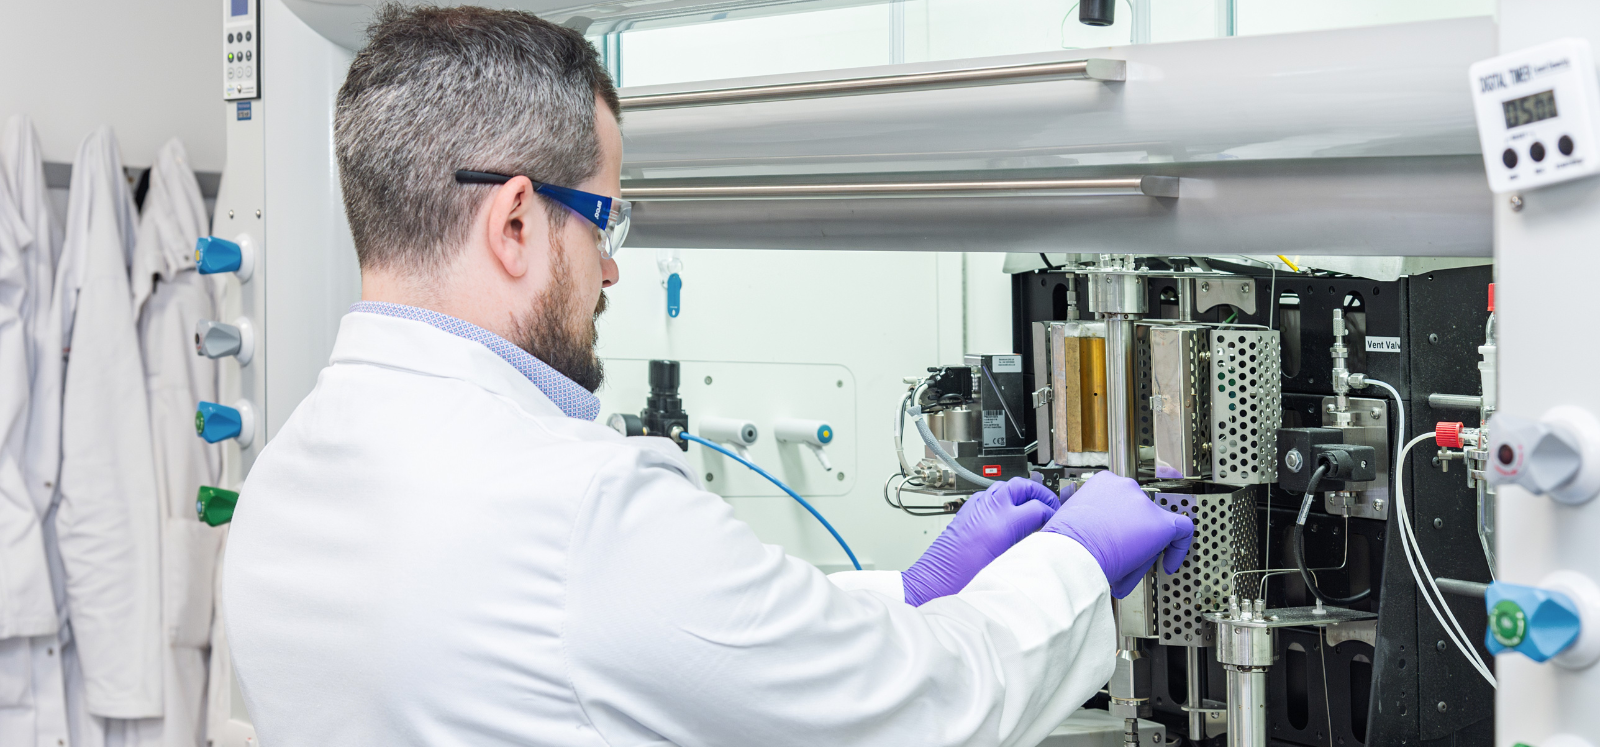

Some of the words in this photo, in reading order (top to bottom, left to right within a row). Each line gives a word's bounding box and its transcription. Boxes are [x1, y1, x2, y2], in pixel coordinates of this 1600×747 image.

[1479, 72, 1507, 93] DIGITAL
[1509, 65, 1531, 85] TIMER
[1367, 340, 1384, 349] Vent
